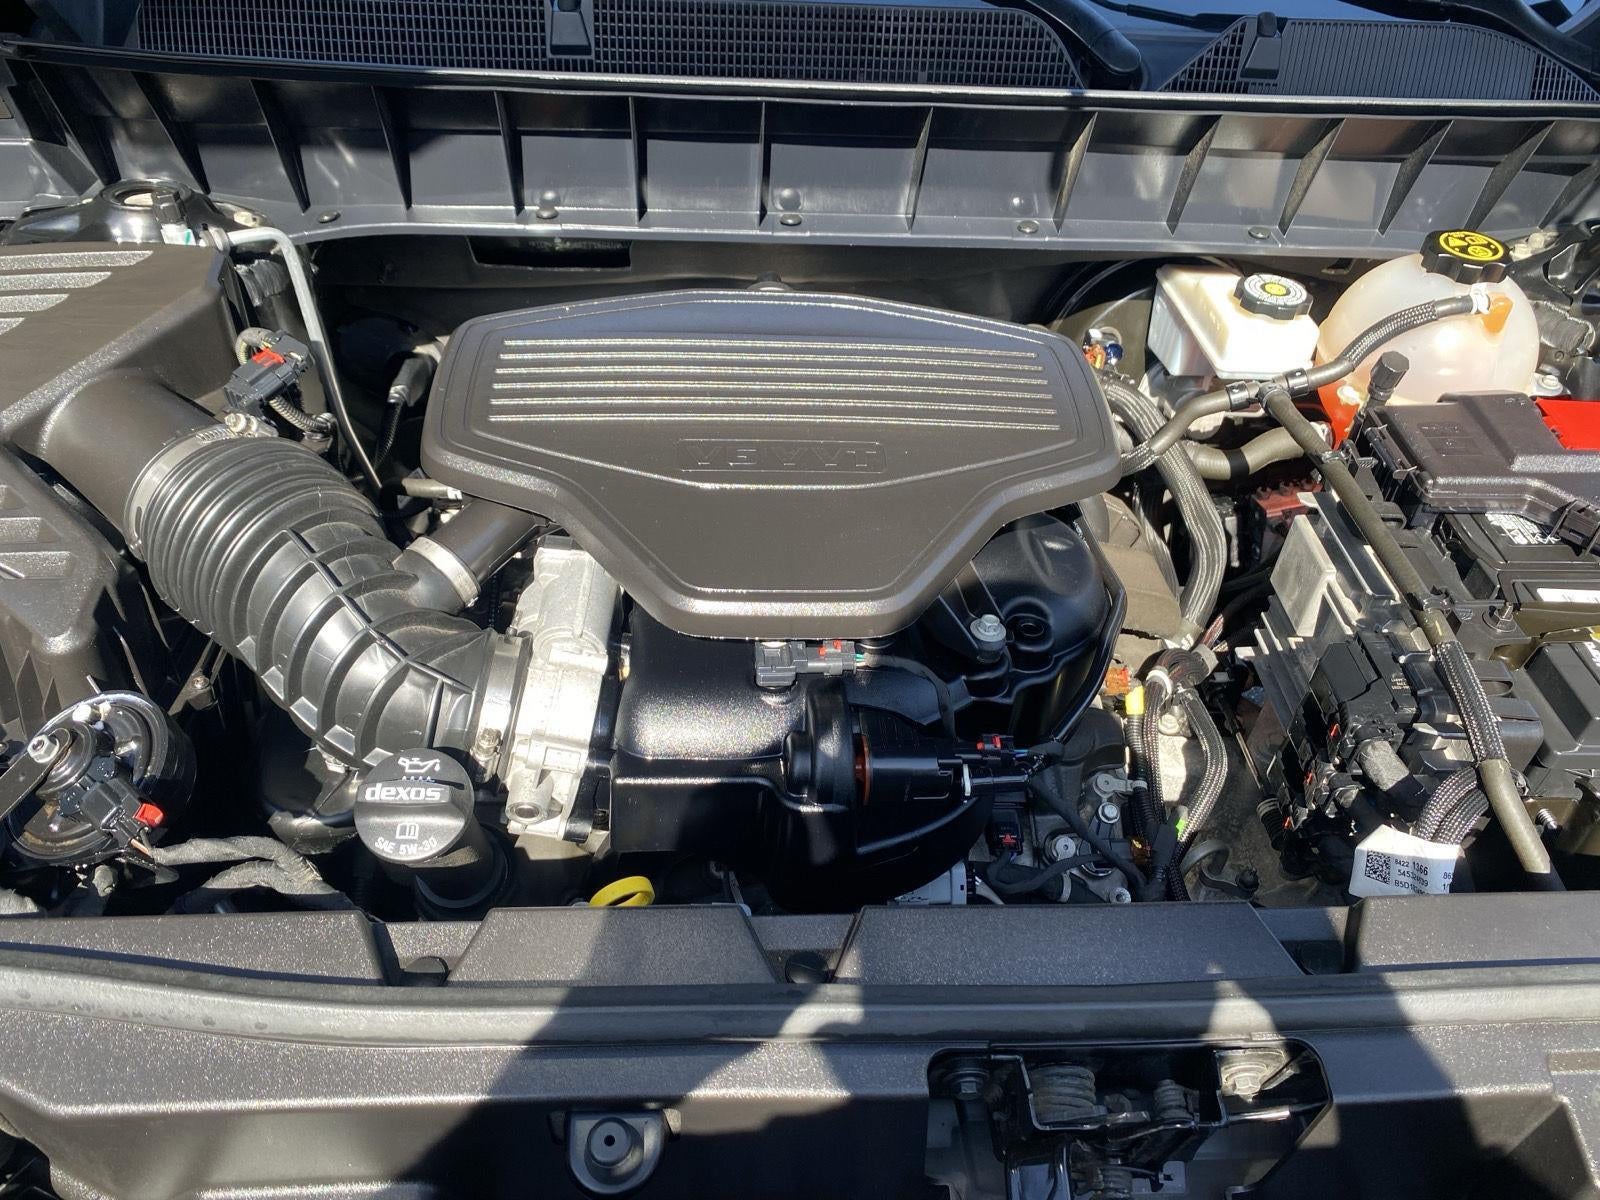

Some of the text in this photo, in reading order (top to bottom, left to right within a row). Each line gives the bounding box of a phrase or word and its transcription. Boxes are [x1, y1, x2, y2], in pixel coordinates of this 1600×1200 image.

[365, 783, 442, 801] dexos
[375, 837, 396, 854] SAE
[1412, 861, 1428, 876] 1366
